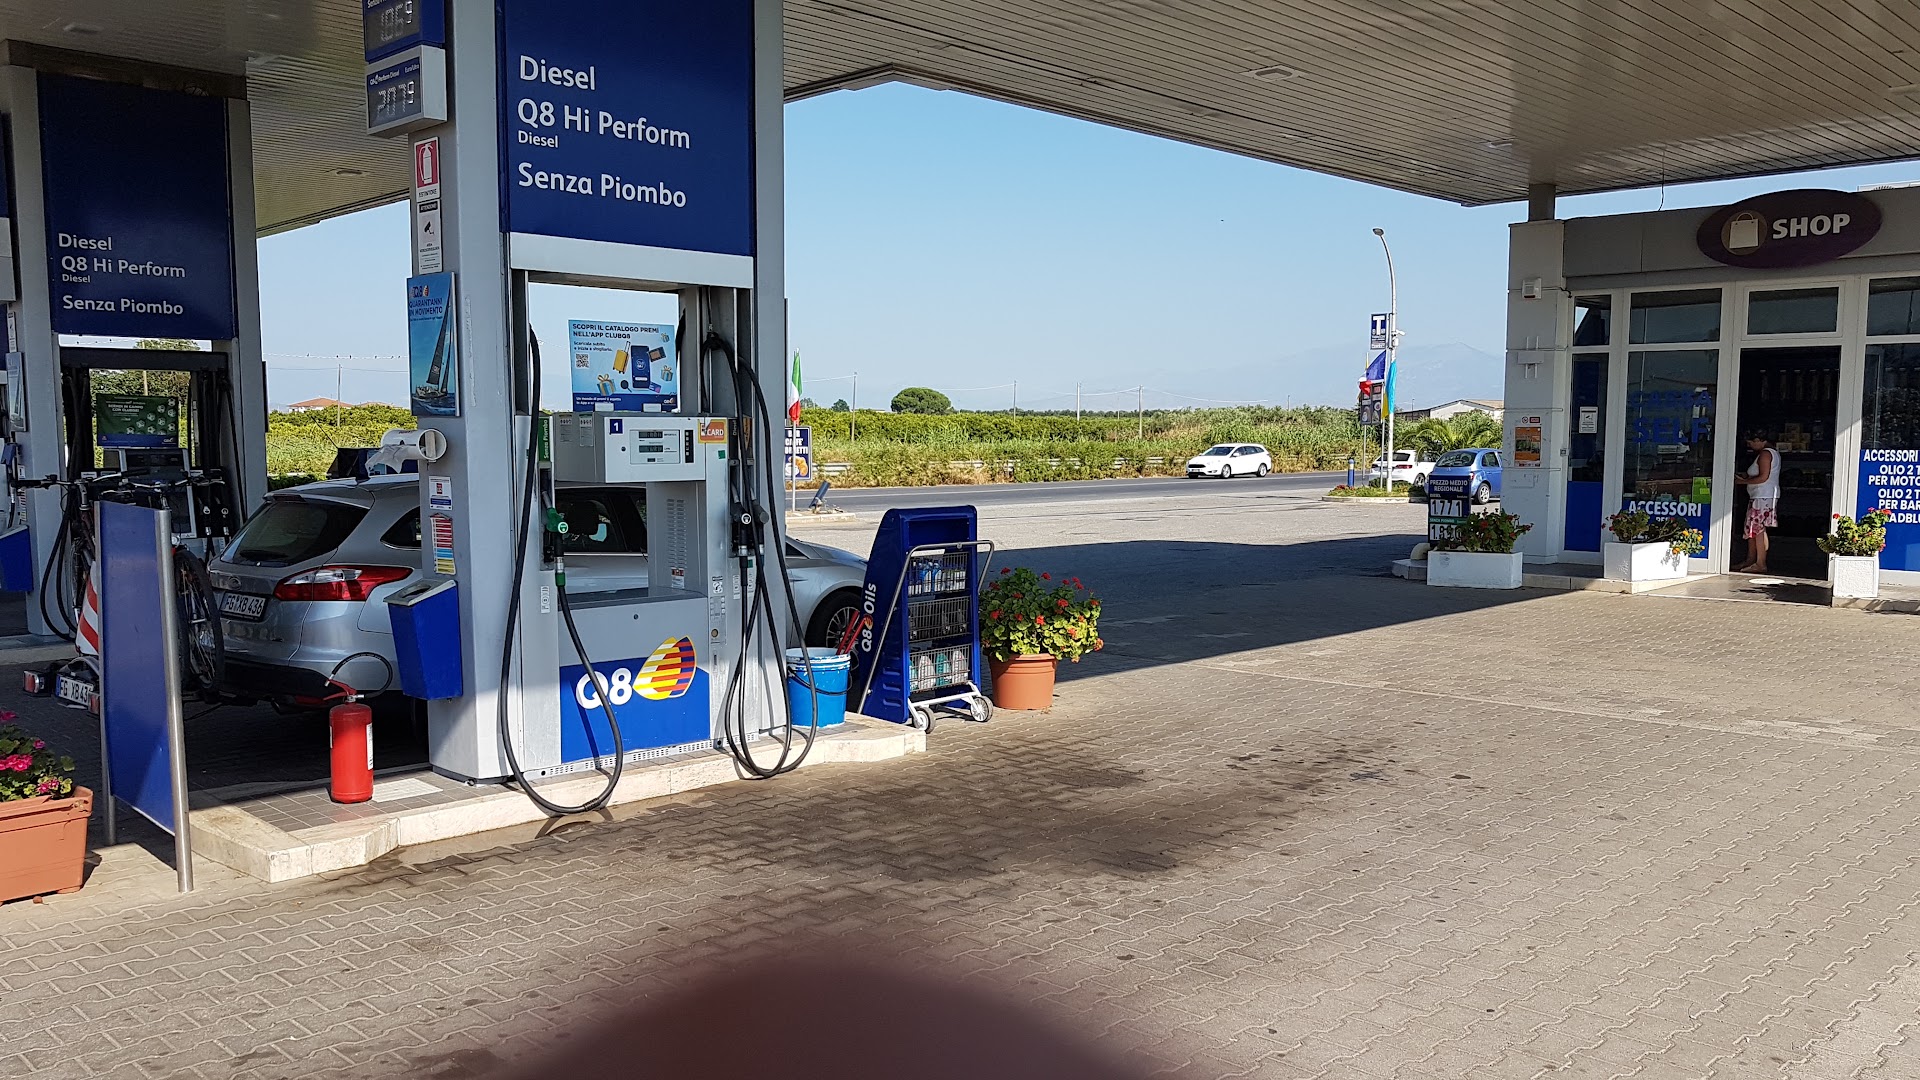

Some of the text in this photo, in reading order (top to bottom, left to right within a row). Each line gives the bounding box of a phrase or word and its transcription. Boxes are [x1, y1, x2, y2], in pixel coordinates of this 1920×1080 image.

[520, 55, 595, 90] Diesel
[517, 98, 691, 149] Q8 Hi Perform
[517, 130, 559, 148] Diesel
[518, 162, 687, 208] Senza Piombo
[1772, 213, 1851, 239] SHOP
[58, 233, 113, 250] Diesel
[61, 256, 186, 278] Q8 Hi Perform
[62, 273, 91, 283] Diesel
[62, 295, 184, 315] Senza Piombo
[604, 325, 639, 333] CATALOGO
[613, 422, 619, 432] 1
[706, 428, 724, 436] CARD
[1632, 417, 1709, 443] SELF
[1863, 449, 1918, 462] ACCESSORI
[1880, 464, 1905, 475] OLIO
[1906, 465, 1914, 475] 2
[1868, 475, 1920, 486] PER MOTO
[1878, 488, 1904, 499] OLIO
[1905, 489, 1912, 499] 2
[1431, 499, 1462, 517] 1.771
[1628, 500, 1702, 517] ACCESSORI
[1878, 499, 1898, 510] PER
[861, 583, 877, 653] Q8 Oils
[60, 679, 68, 696] FG
[70, 682, 80, 700] XB
[575, 667, 633, 710] Q8
